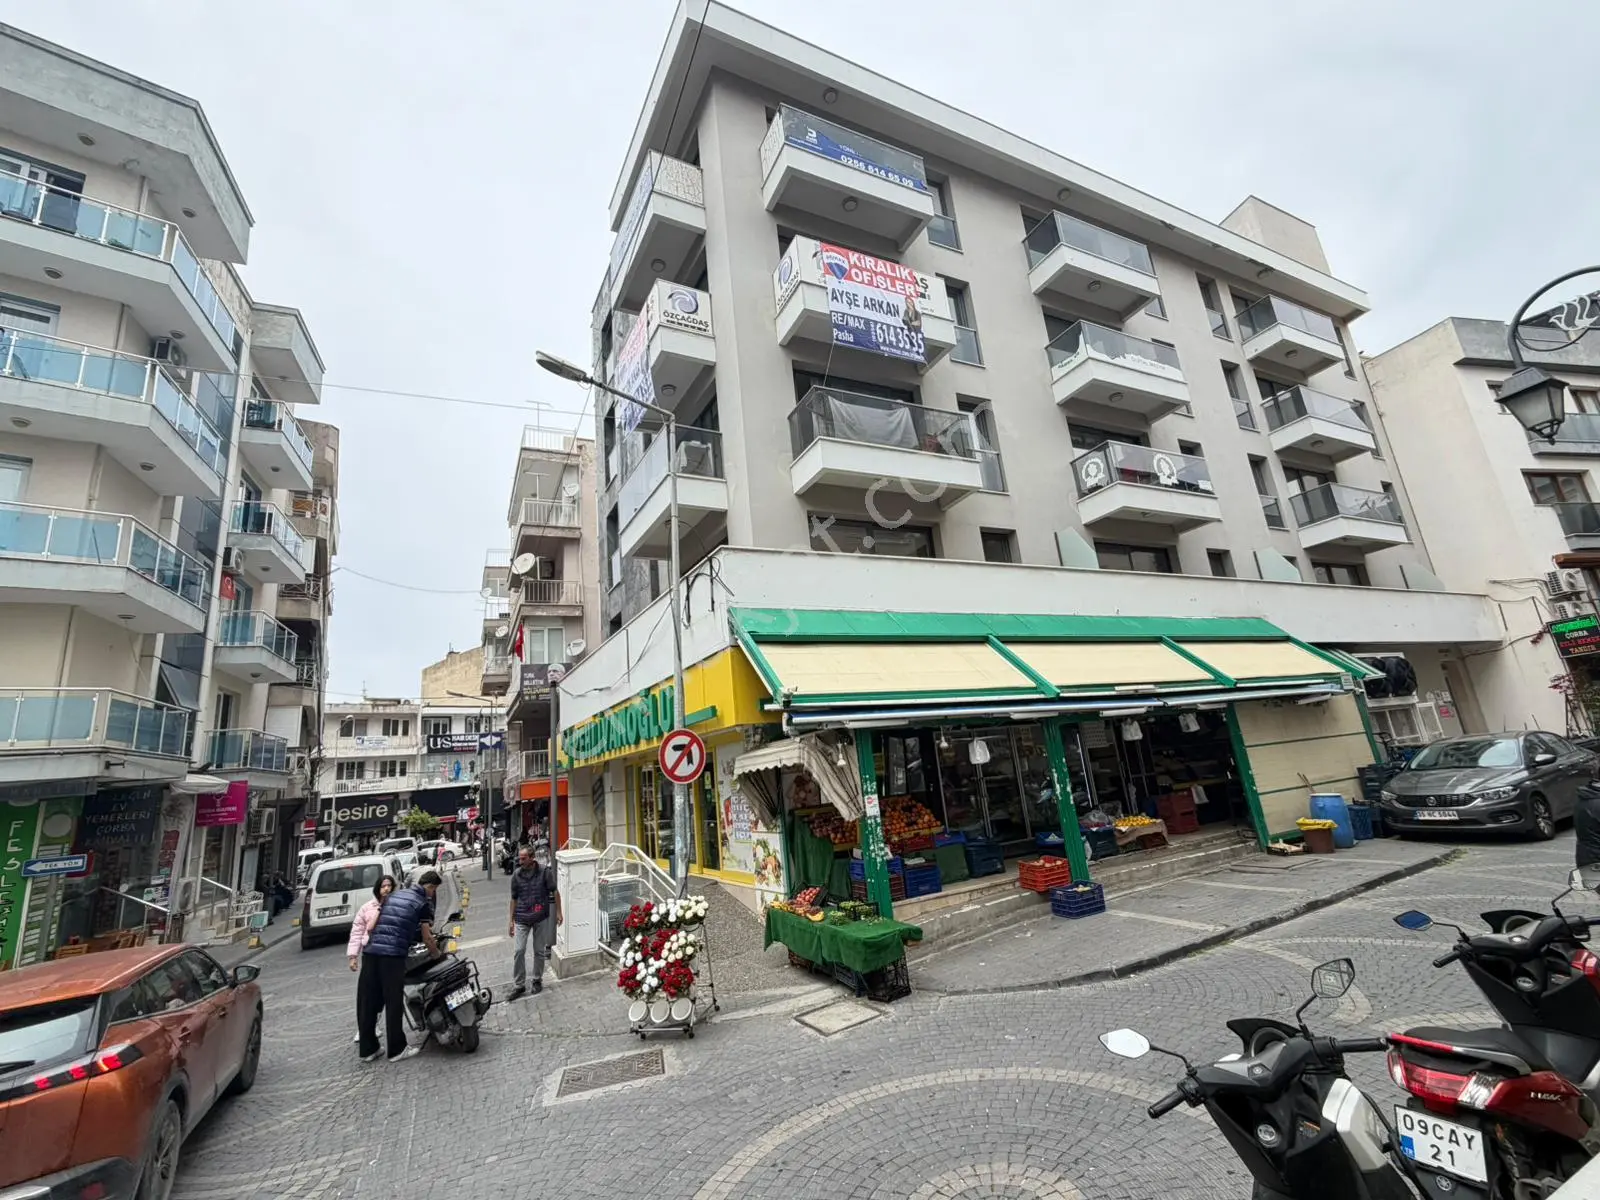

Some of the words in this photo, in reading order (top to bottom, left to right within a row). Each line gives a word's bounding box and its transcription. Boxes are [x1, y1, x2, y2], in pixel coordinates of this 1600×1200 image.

[841, 154, 865, 170] 0256
[867, 164, 886, 177] 614
[888, 171, 900, 182] 65
[901, 177, 914, 188] 09
[848, 251, 914, 281] KİRALIK
[831, 287, 861, 309] AYŞE
[863, 295, 900, 319] ARKAN
[662, 309, 710, 328] ÖZÇAĞDAŞ
[831, 311, 866, 331] RE/MAX
[833, 328, 854, 343] Pasha
[323, 803, 389, 823] Desire
[1403, 1114, 1475, 1150] 09CAY
[1430, 1143, 1455, 1166] 21
